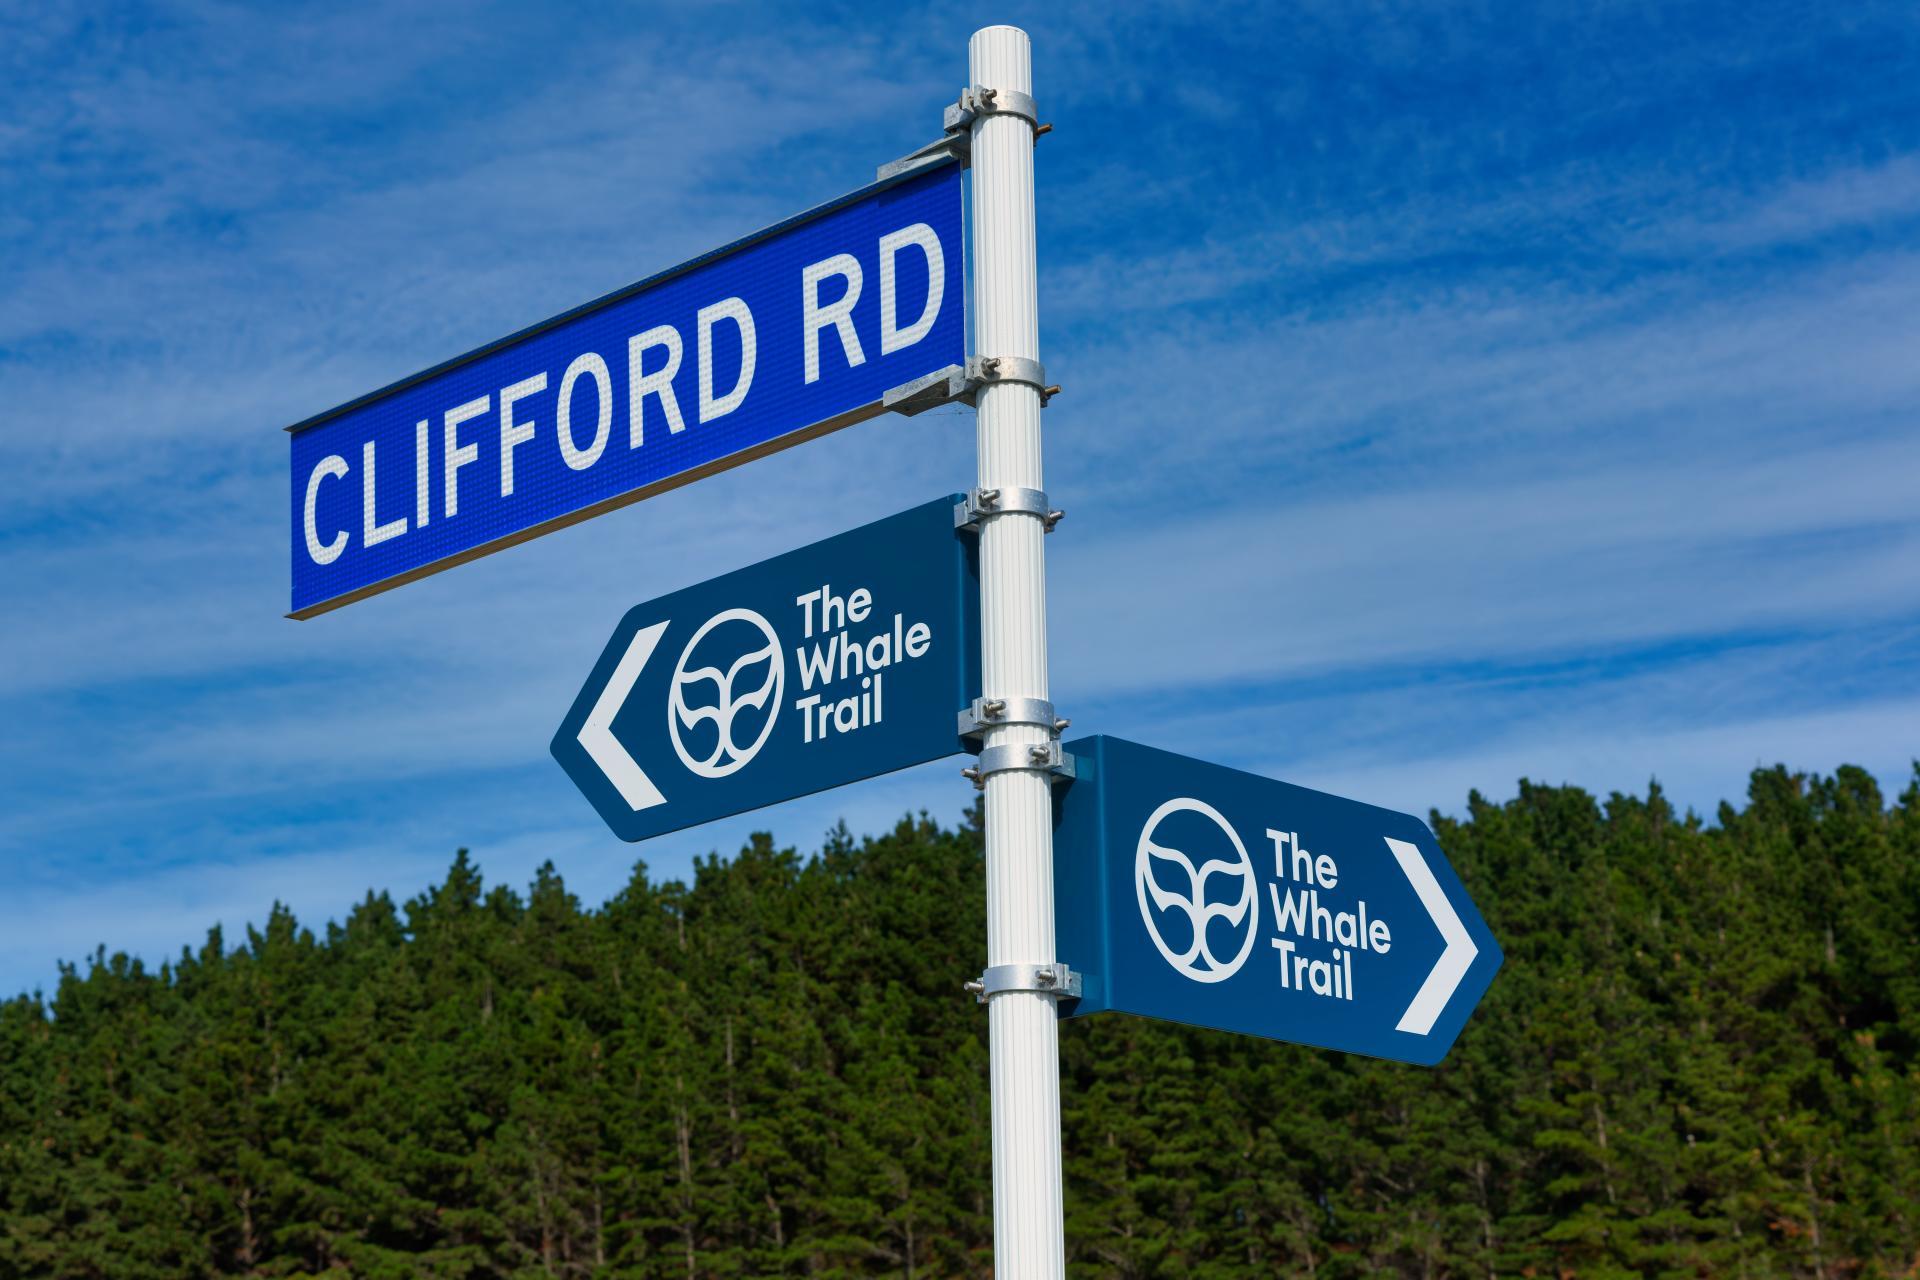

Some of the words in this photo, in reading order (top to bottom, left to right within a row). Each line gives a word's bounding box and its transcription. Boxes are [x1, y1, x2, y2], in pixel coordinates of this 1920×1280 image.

[303, 297, 758, 566] CLIFFORD
[802, 223, 945, 385] RD
[796, 584, 873, 638] The
[796, 613, 932, 691] Whale
[796, 673, 882, 744] Trail
[1265, 828, 1338, 890] The
[1268, 883, 1392, 955] Whale
[1271, 938, 1353, 1001] Trail
